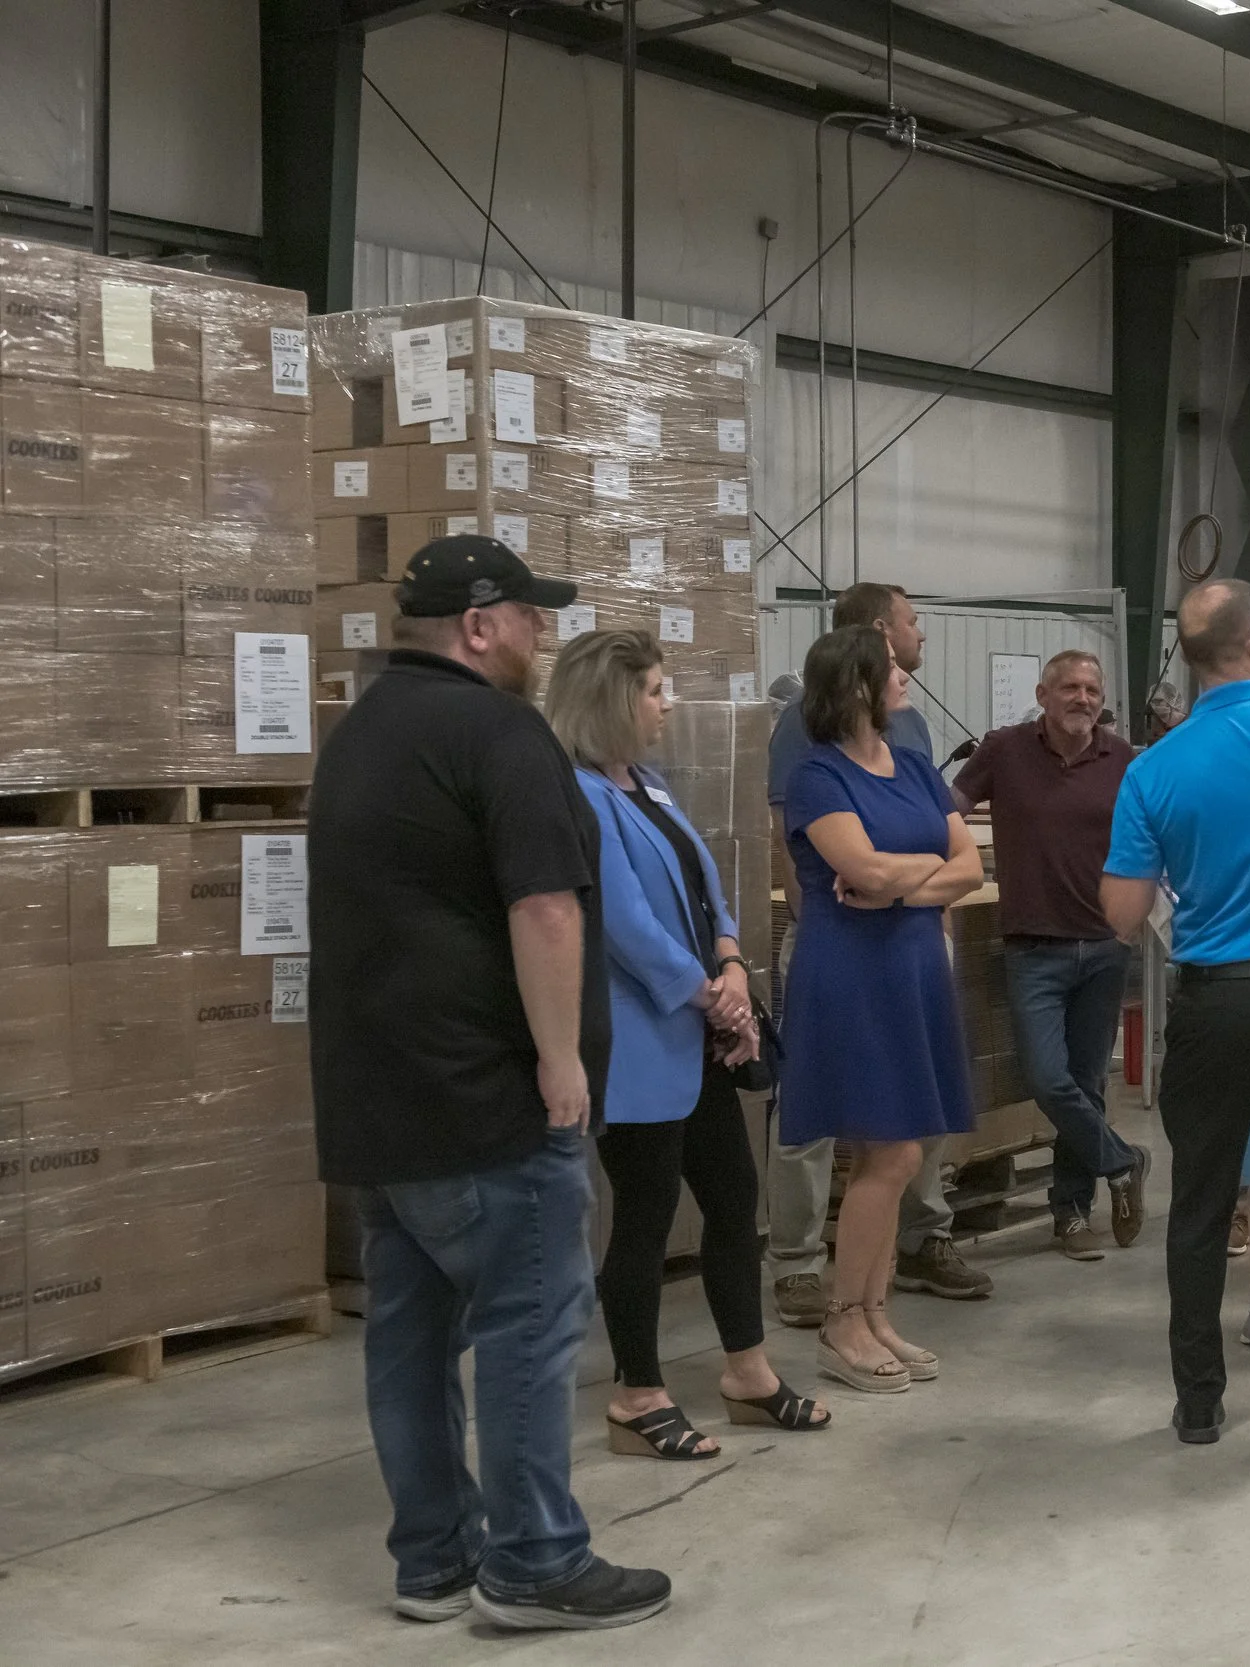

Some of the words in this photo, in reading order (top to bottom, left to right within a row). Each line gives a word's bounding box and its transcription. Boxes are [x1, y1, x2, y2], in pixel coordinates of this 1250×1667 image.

[272, 332, 305, 347] 58124
[281, 362, 298, 378] 27
[8, 440, 78, 461] COOKIES
[254, 587, 312, 604] COOKIES
[274, 962, 309, 975] 58124
[282, 991, 300, 1006] 27
[198, 1002, 260, 1022] COOKIES
[30, 1147, 99, 1173] COOKIES
[33, 1277, 101, 1304] COOKIES
